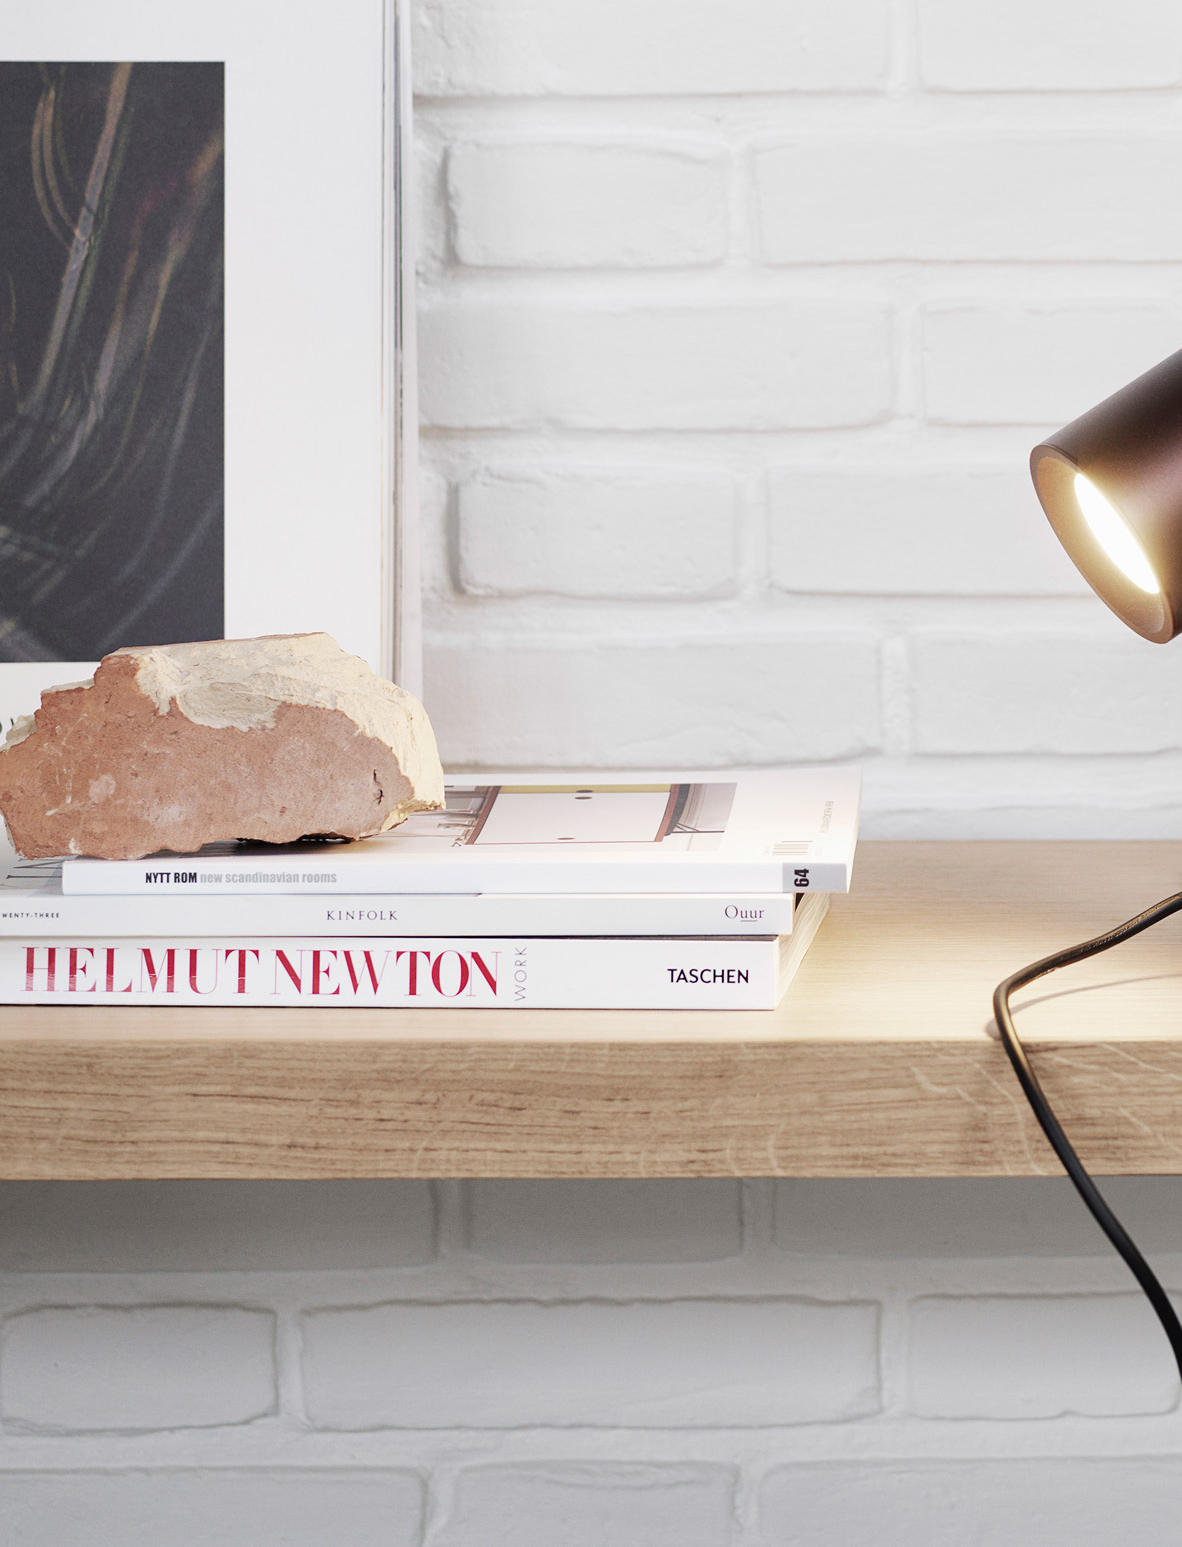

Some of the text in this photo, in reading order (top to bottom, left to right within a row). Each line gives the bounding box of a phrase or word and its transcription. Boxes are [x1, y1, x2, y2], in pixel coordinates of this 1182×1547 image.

[145, 870, 337, 884] NYTT ROM new scandinavian rooms
[793, 867, 810, 887] 64
[326, 910, 398, 921] KINFOLK
[724, 904, 765, 919] Ouur
[20, 946, 503, 999] HELMUT NEWTON
[514, 946, 528, 1001] WORK
[667, 968, 749, 984] TASCHEN
